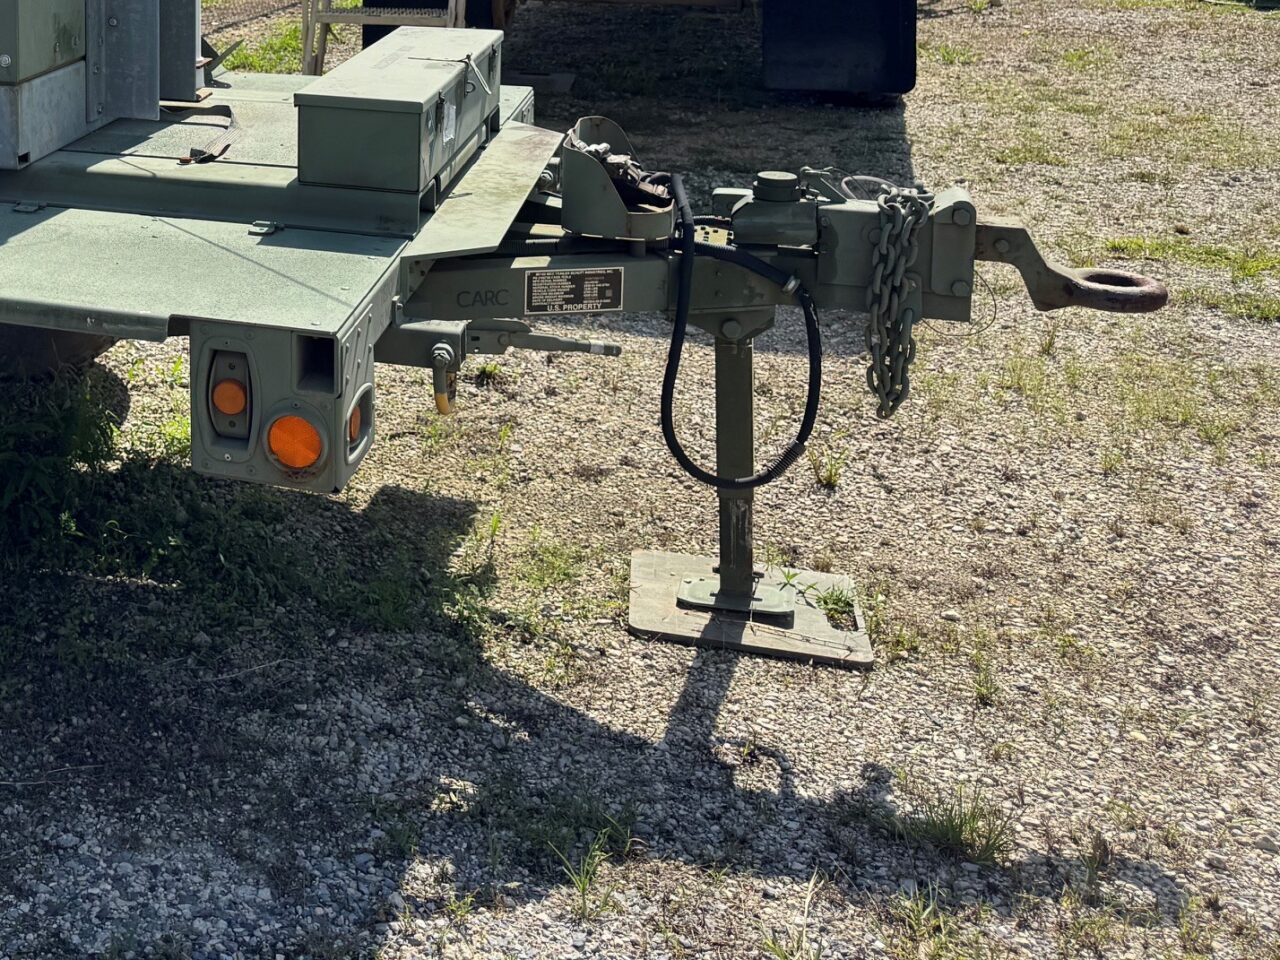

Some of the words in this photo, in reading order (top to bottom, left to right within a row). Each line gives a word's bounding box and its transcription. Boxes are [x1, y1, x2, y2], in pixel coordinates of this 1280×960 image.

[456, 289, 509, 308] CARC
[547, 304, 561, 312] U.S.
[562, 302, 602, 311] PROPERTY
